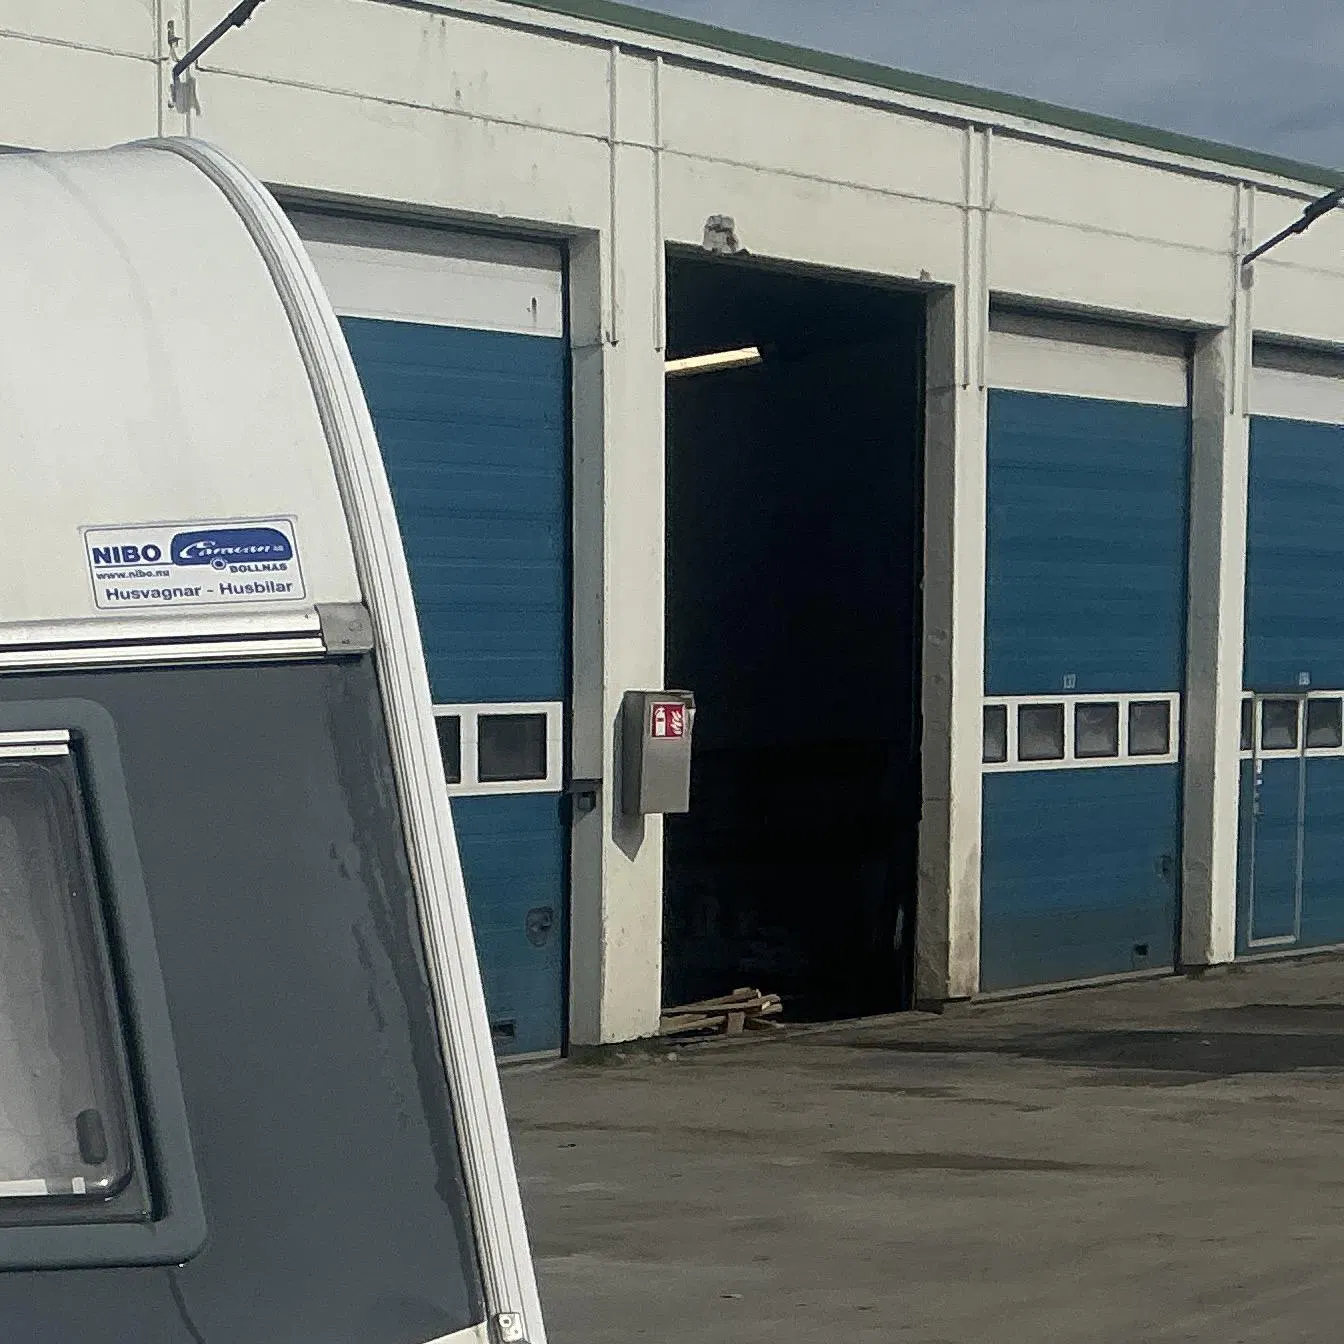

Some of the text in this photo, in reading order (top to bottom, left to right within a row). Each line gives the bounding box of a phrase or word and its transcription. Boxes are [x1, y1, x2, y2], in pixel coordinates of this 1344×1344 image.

[91, 544, 162, 564] NIBO
[96, 569, 170, 580] www.nibo.nu
[105, 586, 202, 600] Husvagnar
[219, 580, 293, 595] Husbilar
